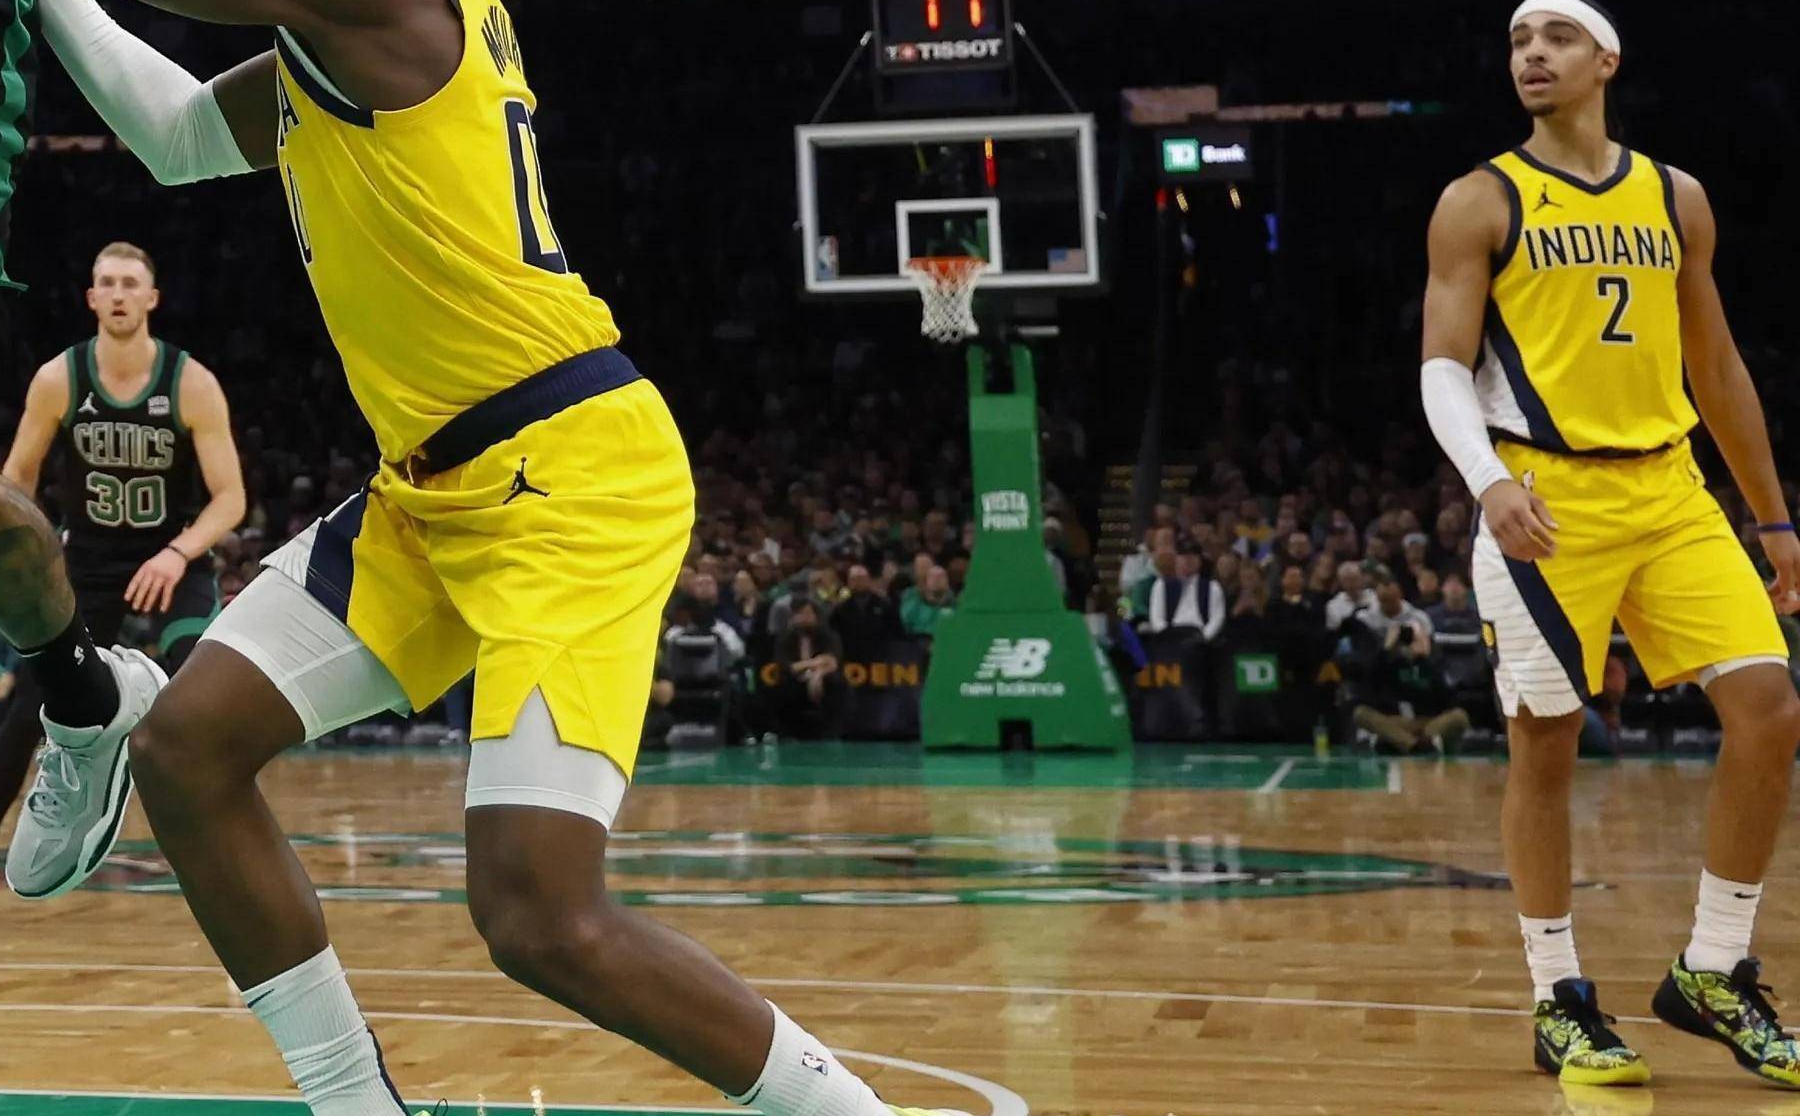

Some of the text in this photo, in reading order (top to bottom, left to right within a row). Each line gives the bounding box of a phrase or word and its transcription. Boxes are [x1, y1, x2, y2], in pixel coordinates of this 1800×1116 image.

[1524, 223, 1675, 271] INDIANA
[1596, 275, 1634, 344] 2
[73, 421, 175, 471] CELTICS
[86, 470, 167, 528] 30
